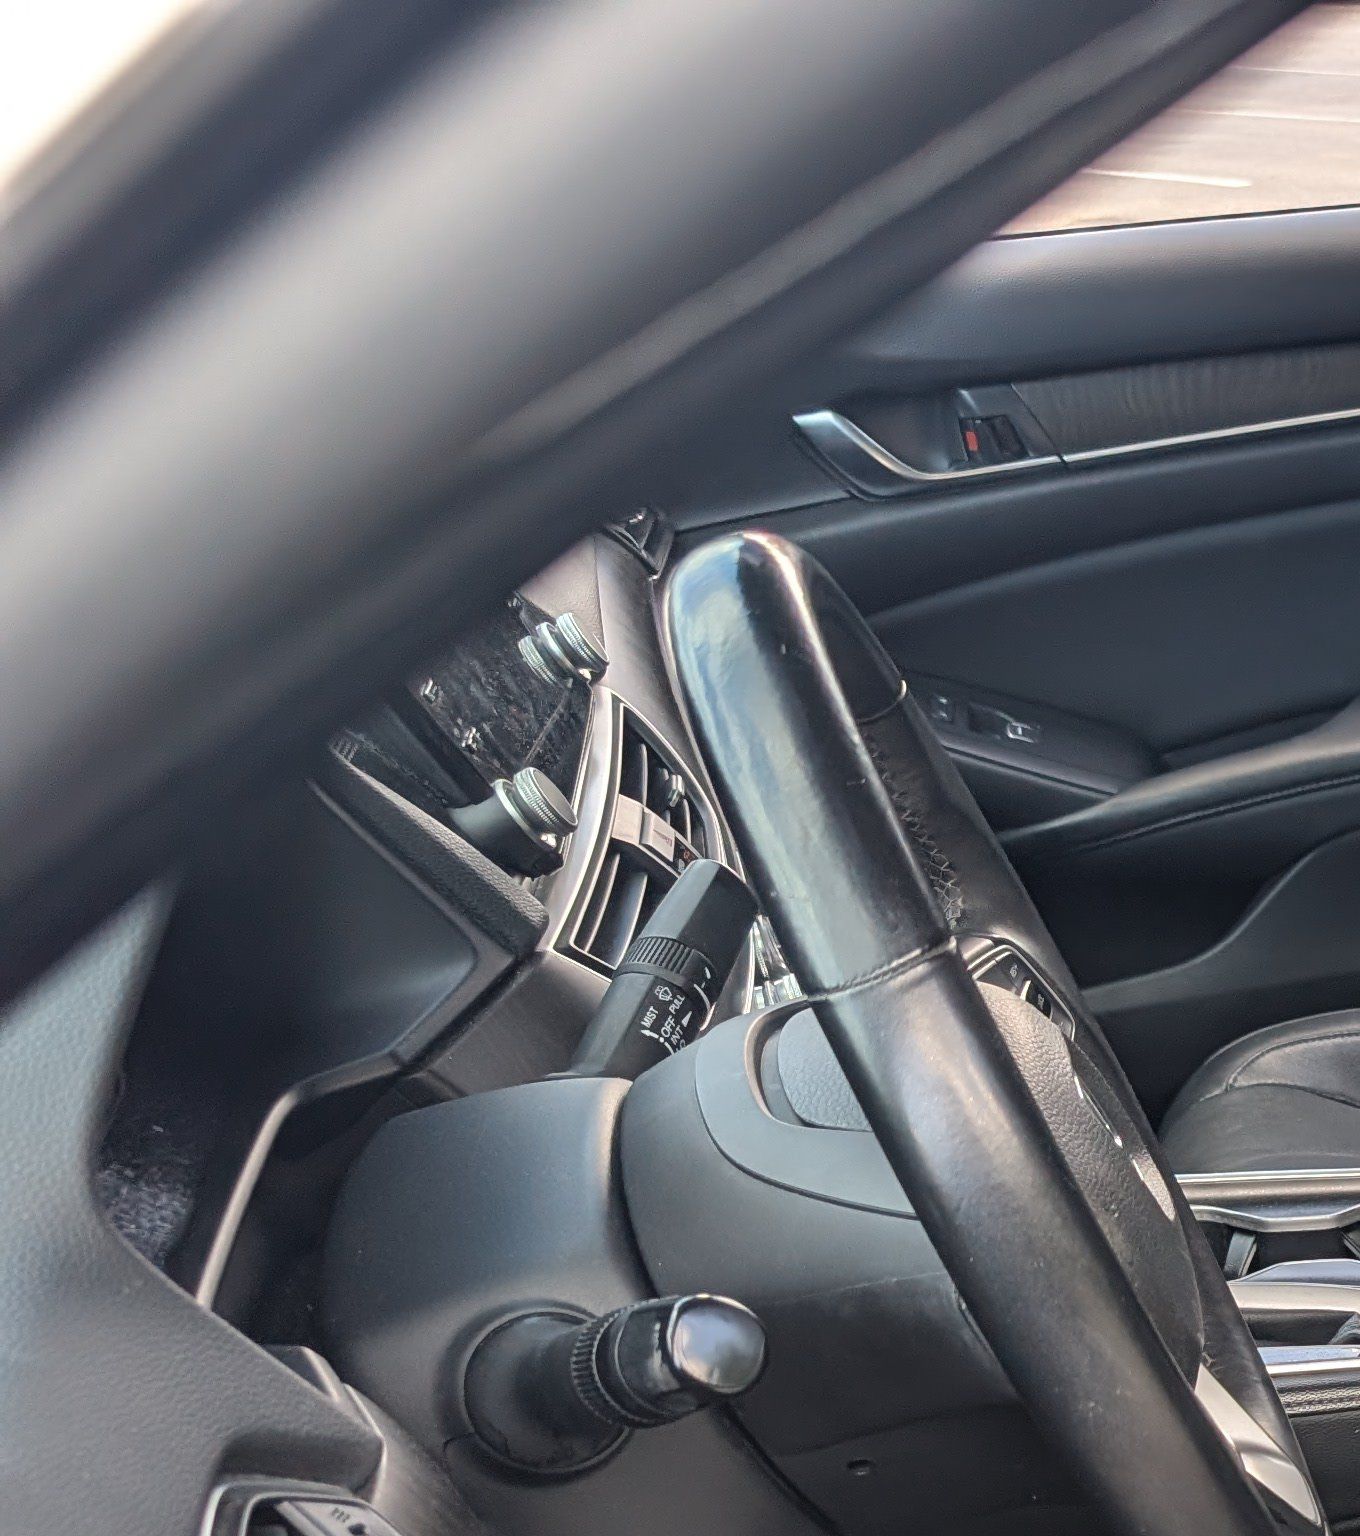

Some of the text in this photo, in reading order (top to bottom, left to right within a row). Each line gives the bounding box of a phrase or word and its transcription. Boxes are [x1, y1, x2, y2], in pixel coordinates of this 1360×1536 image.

[669, 994, 685, 1014] PULL
[640, 1005, 658, 1028] MIST
[661, 1015, 676, 1038] OFF
[671, 1025, 683, 1045] INT
